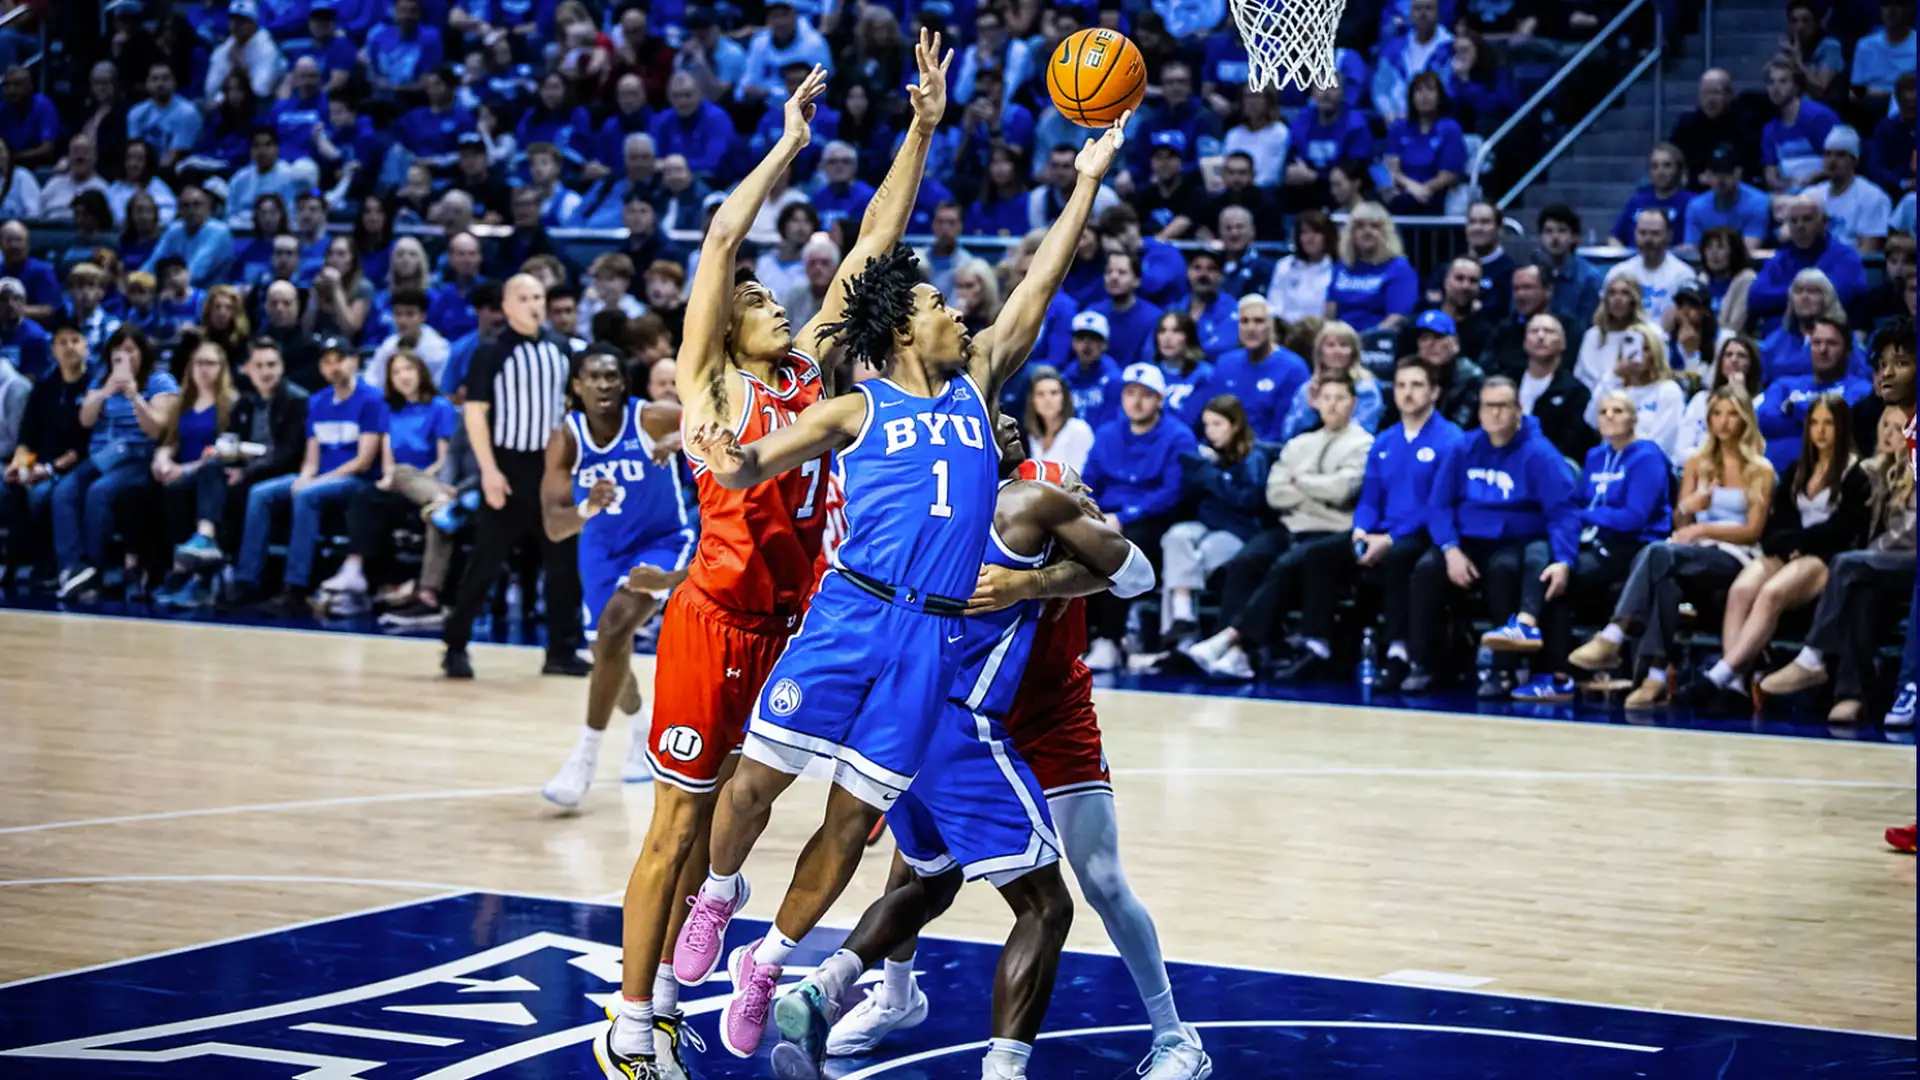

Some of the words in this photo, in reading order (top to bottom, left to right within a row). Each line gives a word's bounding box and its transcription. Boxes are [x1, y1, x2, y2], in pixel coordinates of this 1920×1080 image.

[1084, 29, 1115, 68] ELITE
[883, 412, 984, 456] BYU
[578, 458, 645, 489] BYU
[796, 457, 822, 519] 7
[929, 459, 953, 518] 1
[672, 729, 699, 757] U
